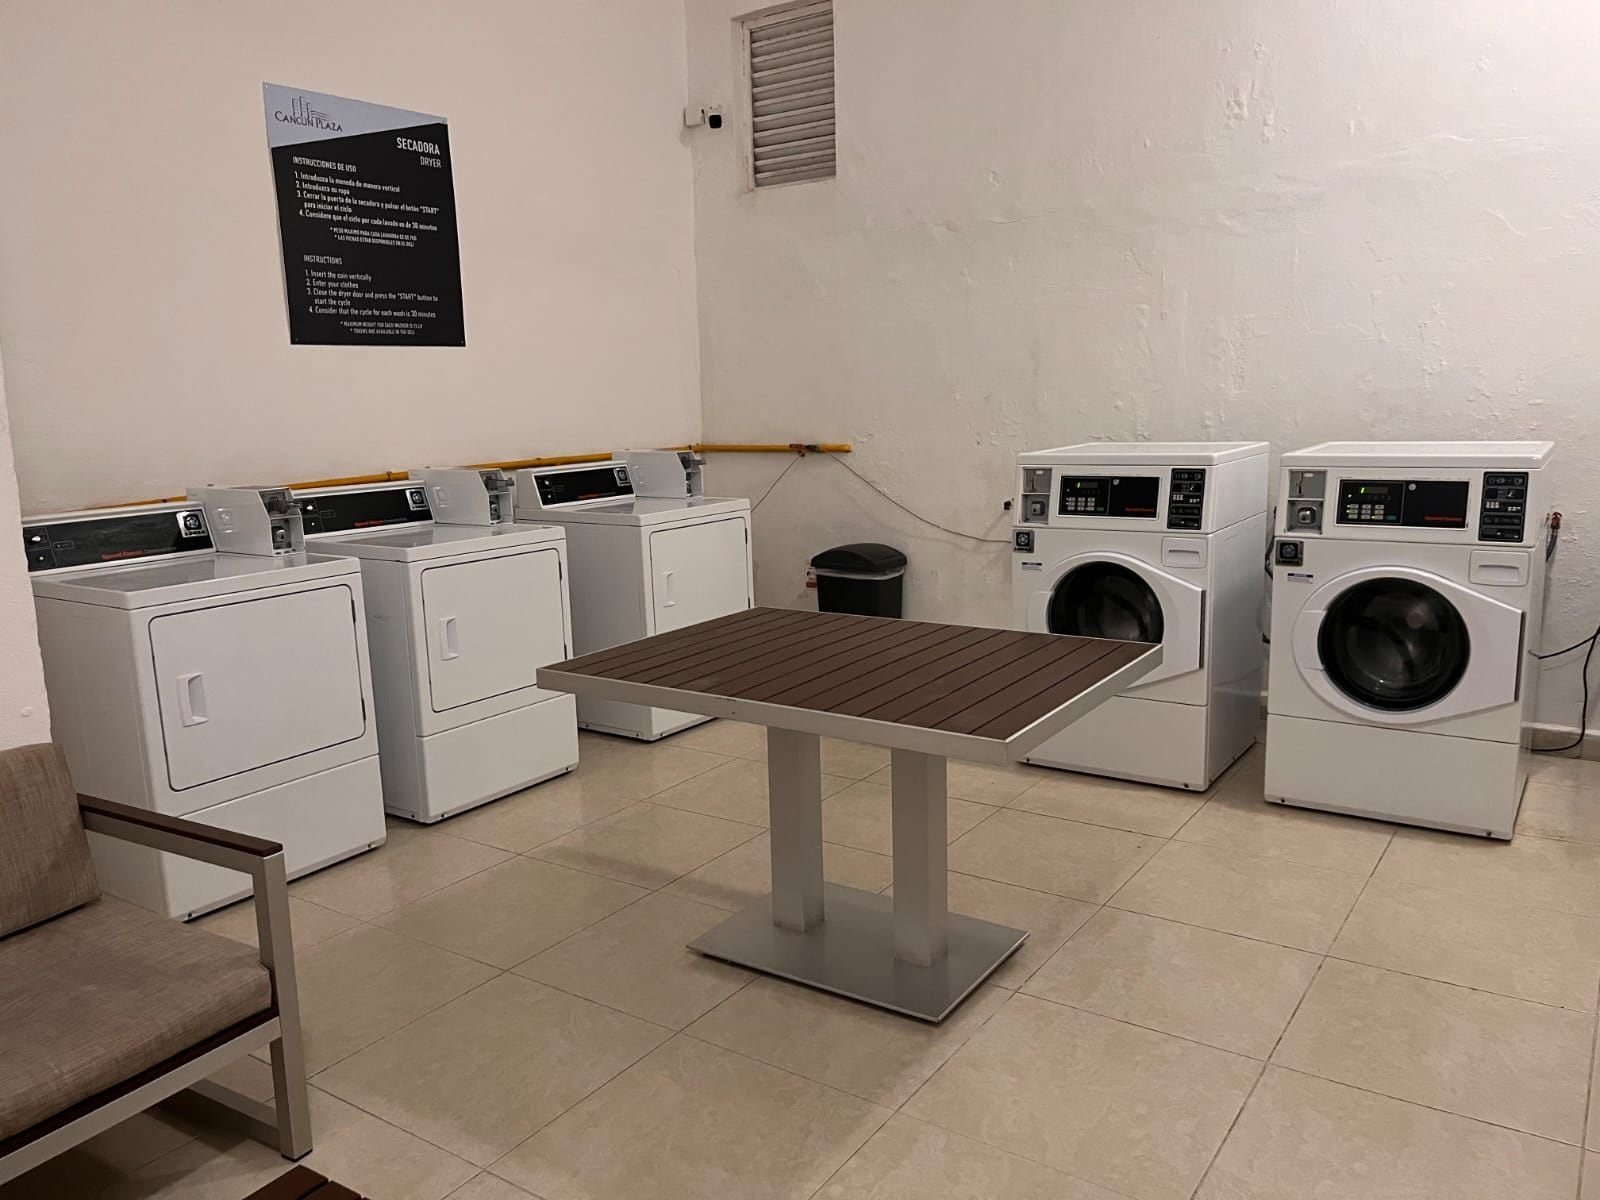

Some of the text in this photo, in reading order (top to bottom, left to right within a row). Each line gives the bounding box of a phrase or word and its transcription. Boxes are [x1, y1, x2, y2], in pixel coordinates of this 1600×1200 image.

[316, 118, 343, 132] PLAZA
[396, 137, 440, 156] SECADORA
[292, 155, 357, 173] INSTRUCCIONES DE USO
[420, 156, 442, 168] DRYER
[294, 170, 300, 179] 1.
[300, 171, 328, 183] Introduzca
[329, 175, 334, 184] la
[335, 178, 355, 187] moneda
[363, 182, 381, 190] manera
[382, 184, 400, 192] vertical
[296, 180, 301, 188] 2.
[302, 181, 330, 192] Introduzca
[297, 190, 302, 198] 3.
[303, 190, 320, 200] Cerrar
[321, 192, 326, 201] la
[345, 196, 351, 204] de
[358, 200, 380, 208] secadora
[385, 202, 399, 210] pulsar
[400, 203, 405, 211] el
[420, 206, 440, 214] "START"
[299, 208, 305, 216] 4.
[303, 254, 342, 265] INSTRUCTIONS
[305, 268, 310, 277] 1.
[311, 269, 326, 278] Insert
[327, 271, 336, 279] the
[348, 273, 372, 282] vertically
[306, 278, 312, 286] 2.
[312, 278, 326, 287] Enter
[340, 281, 359, 289] clothes
[313, 288, 327, 296] Close
[328, 288, 337, 297] the
[338, 290, 351, 298] dryer
[352, 290, 363, 298] door
[364, 290, 374, 298] and
[397, 292, 416, 300] "START"
[337, 298, 350, 306] cycle
[315, 305, 337, 314] Consider
[338, 306, 349, 315] that
[359, 308, 372, 316] cycle
[406, 309, 410, 317] is
